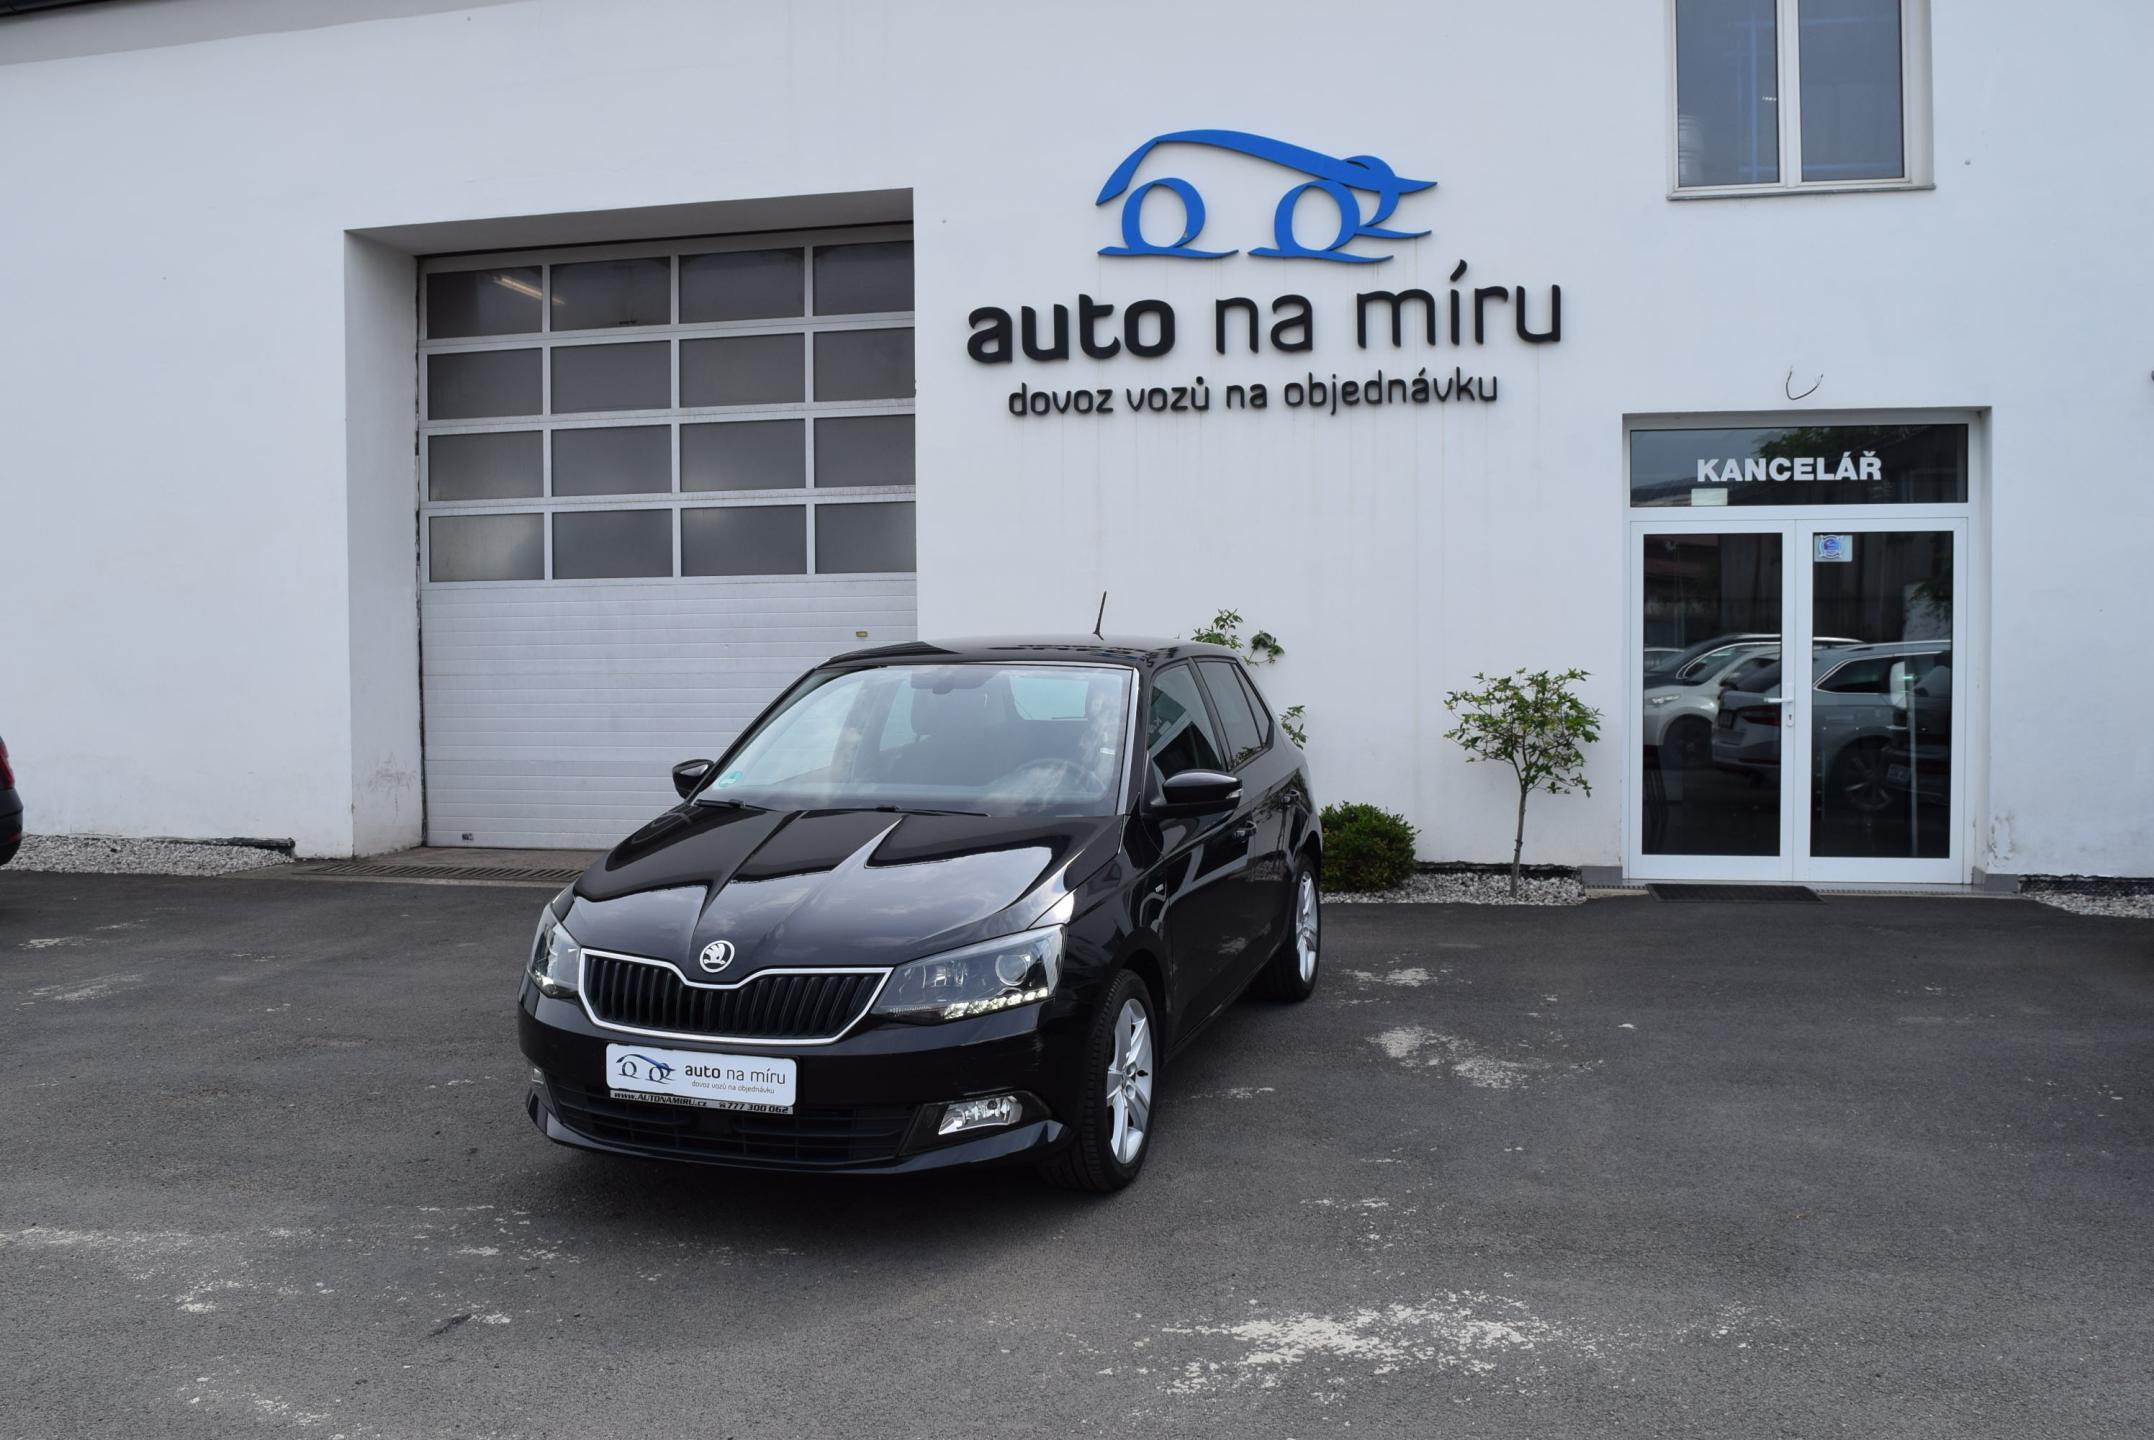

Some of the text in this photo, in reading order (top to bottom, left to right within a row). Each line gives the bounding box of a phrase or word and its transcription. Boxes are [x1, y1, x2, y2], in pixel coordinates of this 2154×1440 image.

[966, 259, 1562, 366] auto na míru
[1008, 366, 1498, 418] dovoz vozů na objednávku
[1697, 450, 1882, 482] KANCELÁŘ
[684, 1064, 786, 1085] auto na míru
[691, 1080, 710, 1089] dovoz
